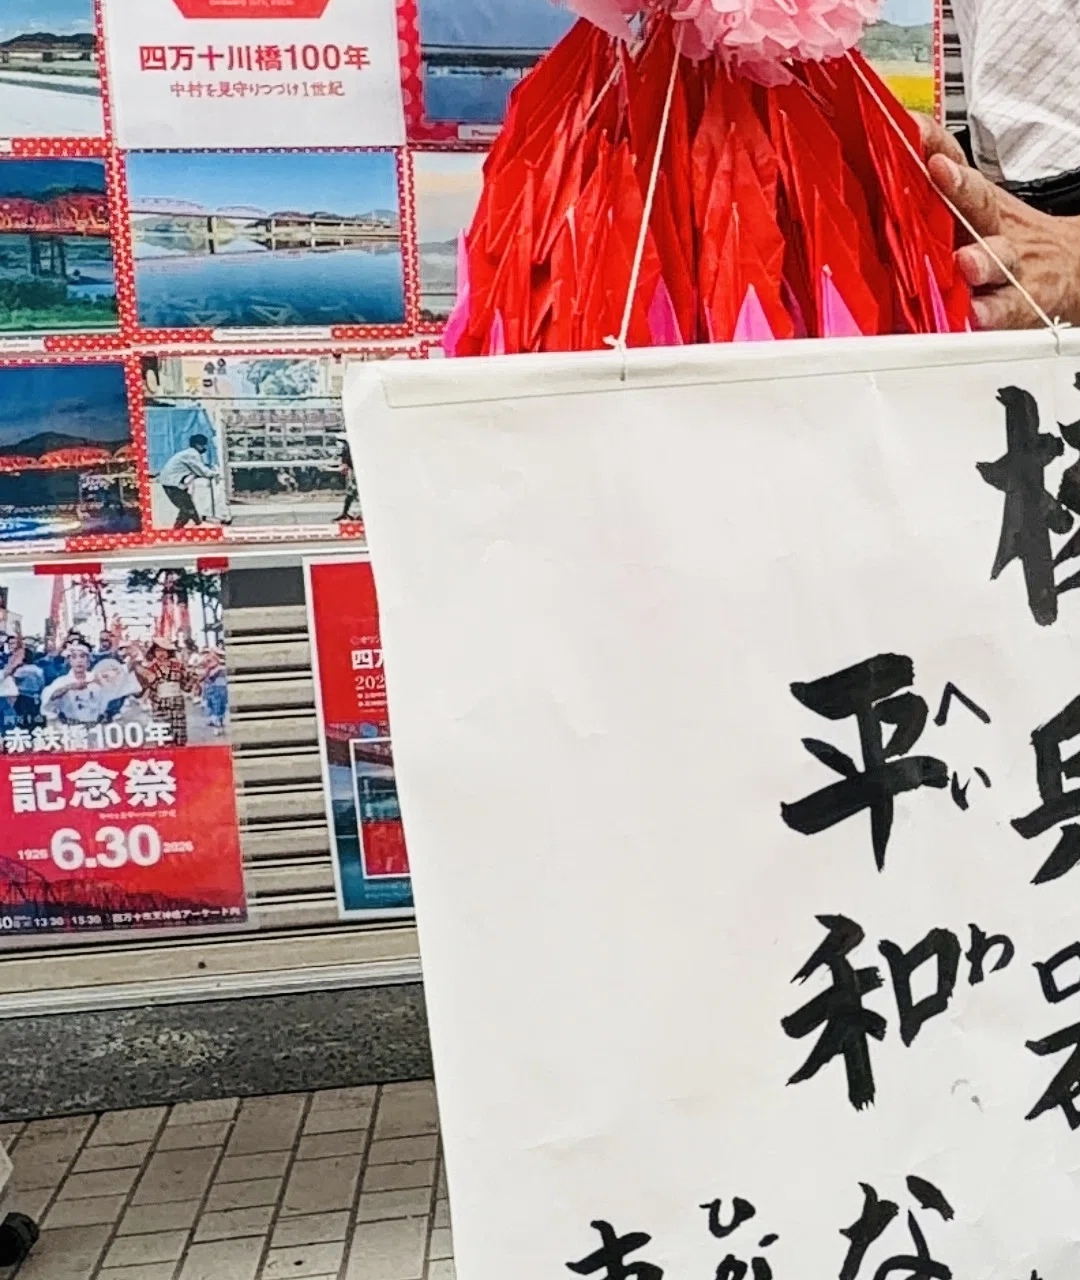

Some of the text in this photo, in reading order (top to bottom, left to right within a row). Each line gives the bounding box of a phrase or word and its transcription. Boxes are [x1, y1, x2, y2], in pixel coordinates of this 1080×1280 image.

[139, 44, 371, 71] 四万十川橋100年
[3, 722, 174, 753] 赤鉄橋100年
[9, 758, 177, 813] 記念祭
[51, 824, 161, 870] 6.30
[934, 682, 991, 811] へい
[965, 924, 1014, 985] わ
